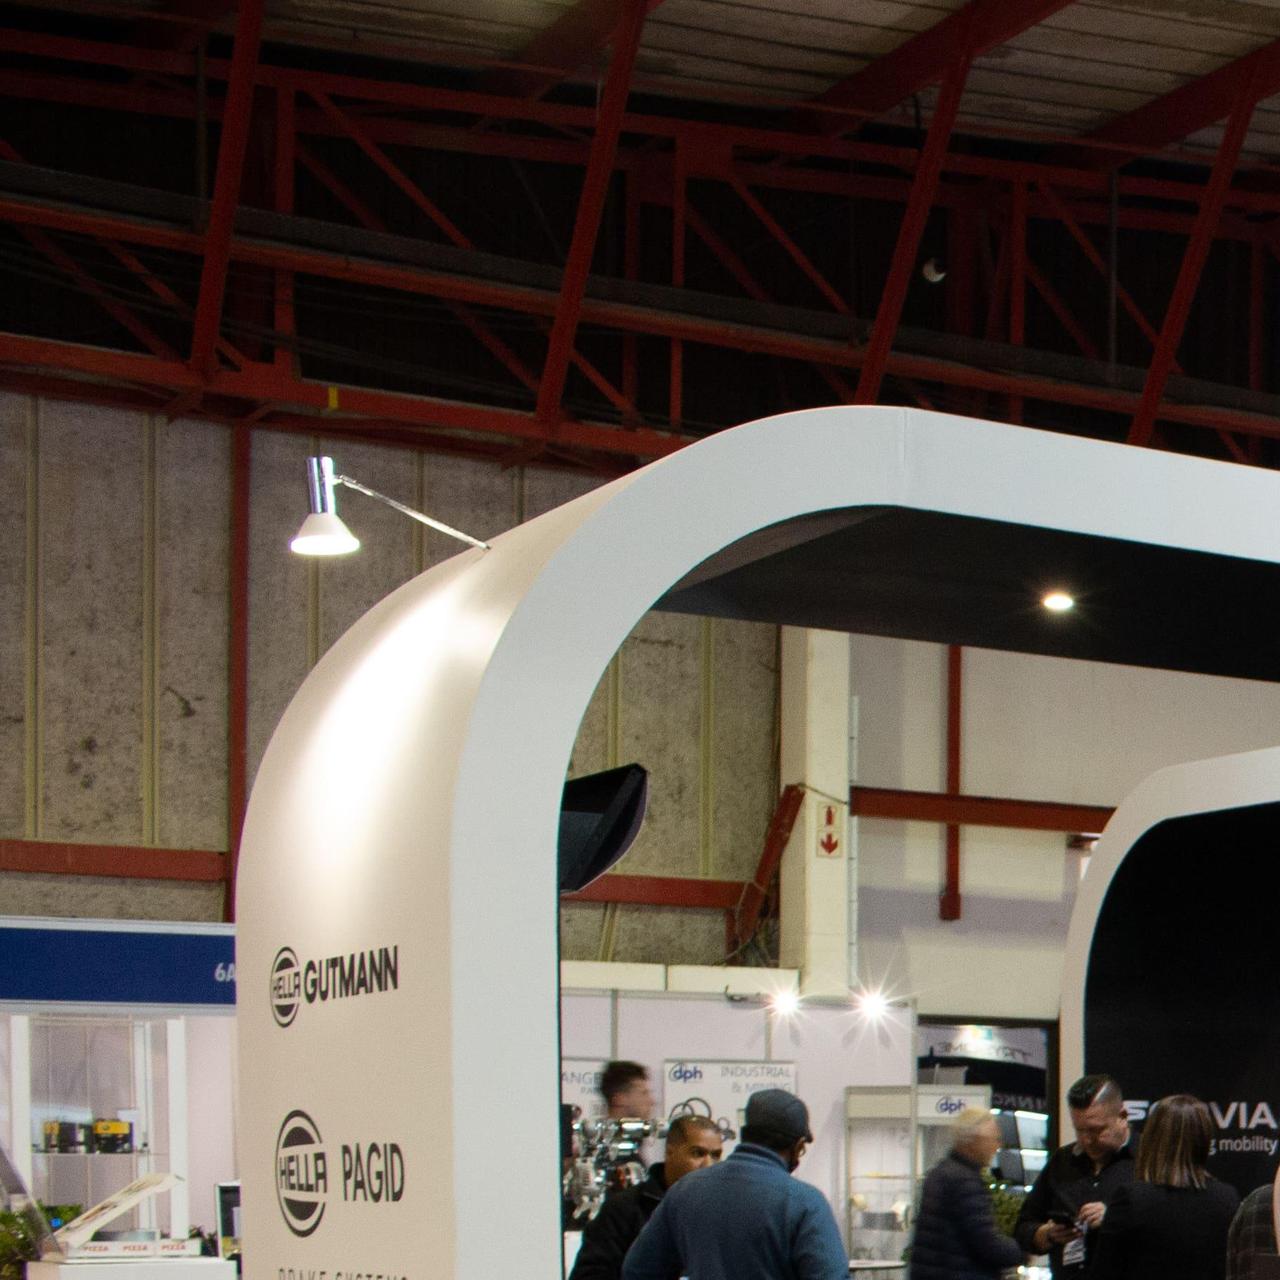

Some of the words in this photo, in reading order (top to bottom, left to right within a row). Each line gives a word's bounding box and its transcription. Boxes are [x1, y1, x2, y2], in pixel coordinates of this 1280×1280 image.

[272, 971, 300, 999] HELLA
[304, 945, 398, 1004] GUTMANN
[673, 1065, 703, 1083] dph
[721, 1065, 791, 1078] INDUSTRIAL
[1219, 1134, 1278, 1156] mobility
[279, 1151, 327, 1194] HELLA
[341, 1142, 405, 1203] PAGID
